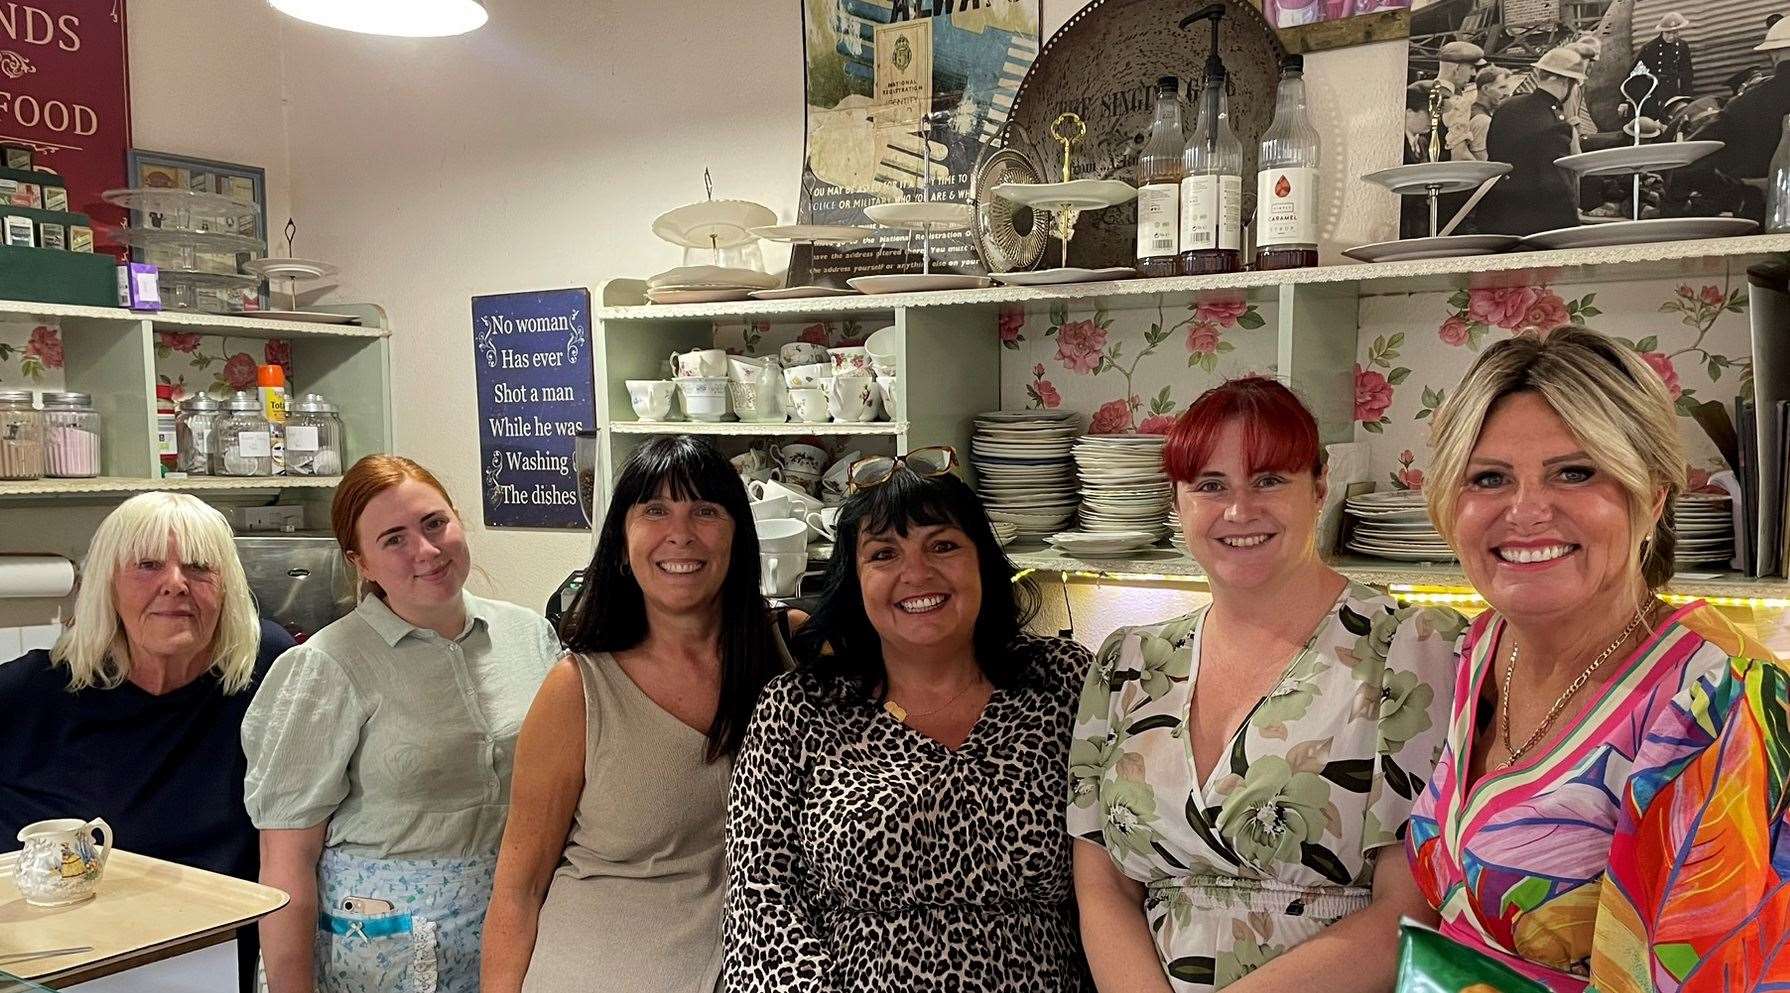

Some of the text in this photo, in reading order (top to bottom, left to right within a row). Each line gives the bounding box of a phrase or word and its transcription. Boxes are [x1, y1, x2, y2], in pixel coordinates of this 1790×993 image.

[958, 174, 968, 183] TO
[838, 200, 851, 209] OR
[930, 191, 948, 201] ARE
[1268, 214, 1298, 222] CARAMEL
[915, 231, 962, 240] Reistration
[491, 316, 569, 335] No woman
[501, 349, 563, 369] Has ever
[494, 382, 574, 403] Shot a man
[489, 416, 583, 437] While he was
[506, 451, 569, 475] Washing
[501, 484, 577, 506] The dishes
